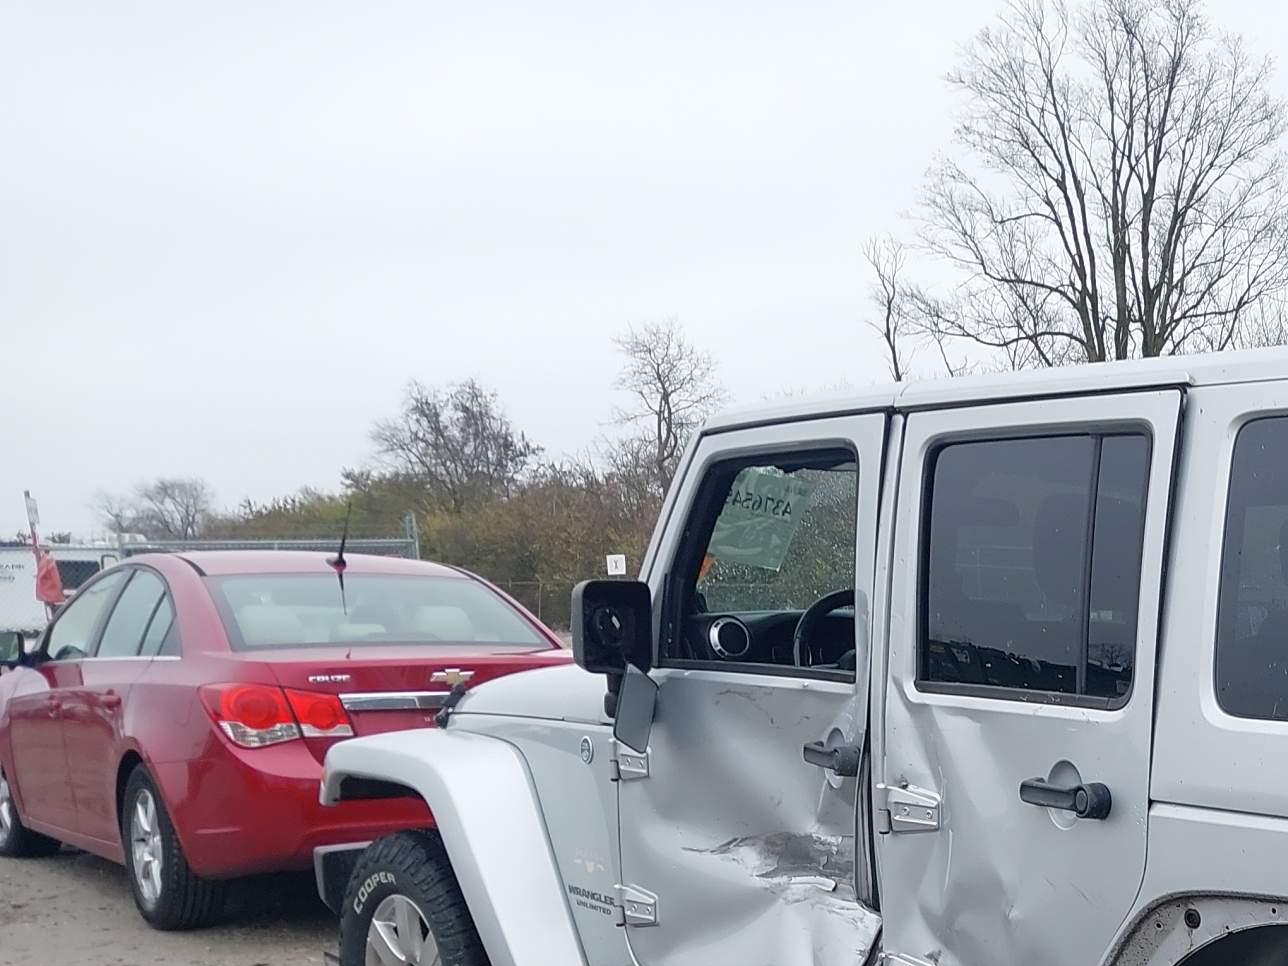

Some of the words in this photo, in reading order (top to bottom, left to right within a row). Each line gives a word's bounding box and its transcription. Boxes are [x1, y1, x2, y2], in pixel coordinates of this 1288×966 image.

[353, 871, 397, 915] COOPER
[568, 884, 616, 907] WRANGLER
[576, 898, 613, 916] UNLIMITED
